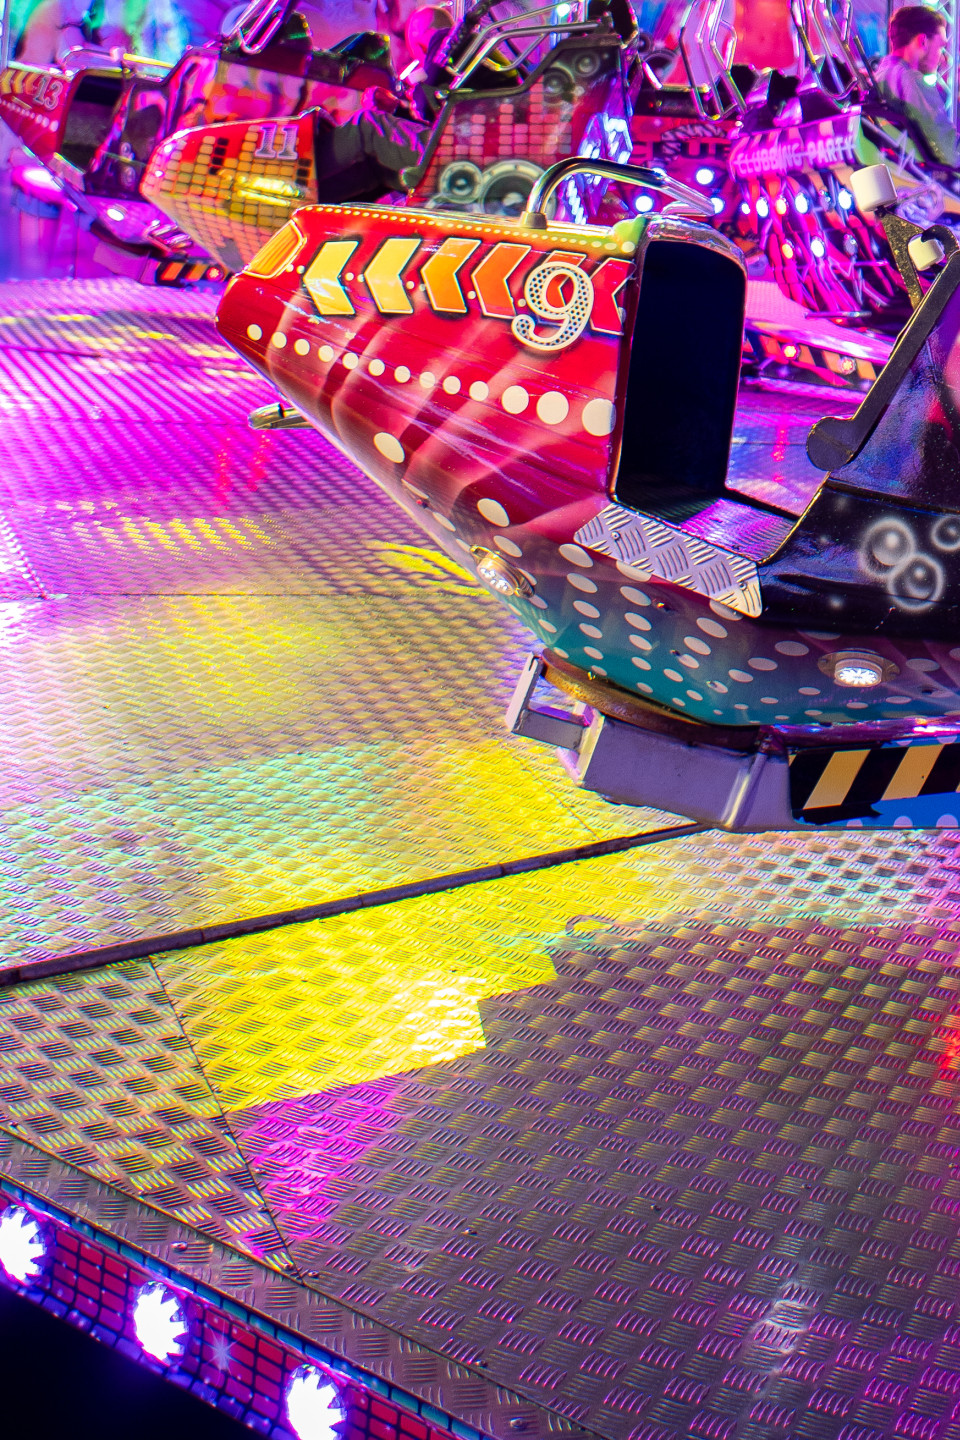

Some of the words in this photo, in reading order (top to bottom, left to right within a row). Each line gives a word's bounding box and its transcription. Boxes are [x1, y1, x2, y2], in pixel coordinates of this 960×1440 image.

[31, 75, 64, 110] 13
[254, 123, 299, 160] 11
[735, 142, 804, 175] CLUBBING
[806, 136, 857, 166] PARTY
[510, 260, 595, 353] 9
